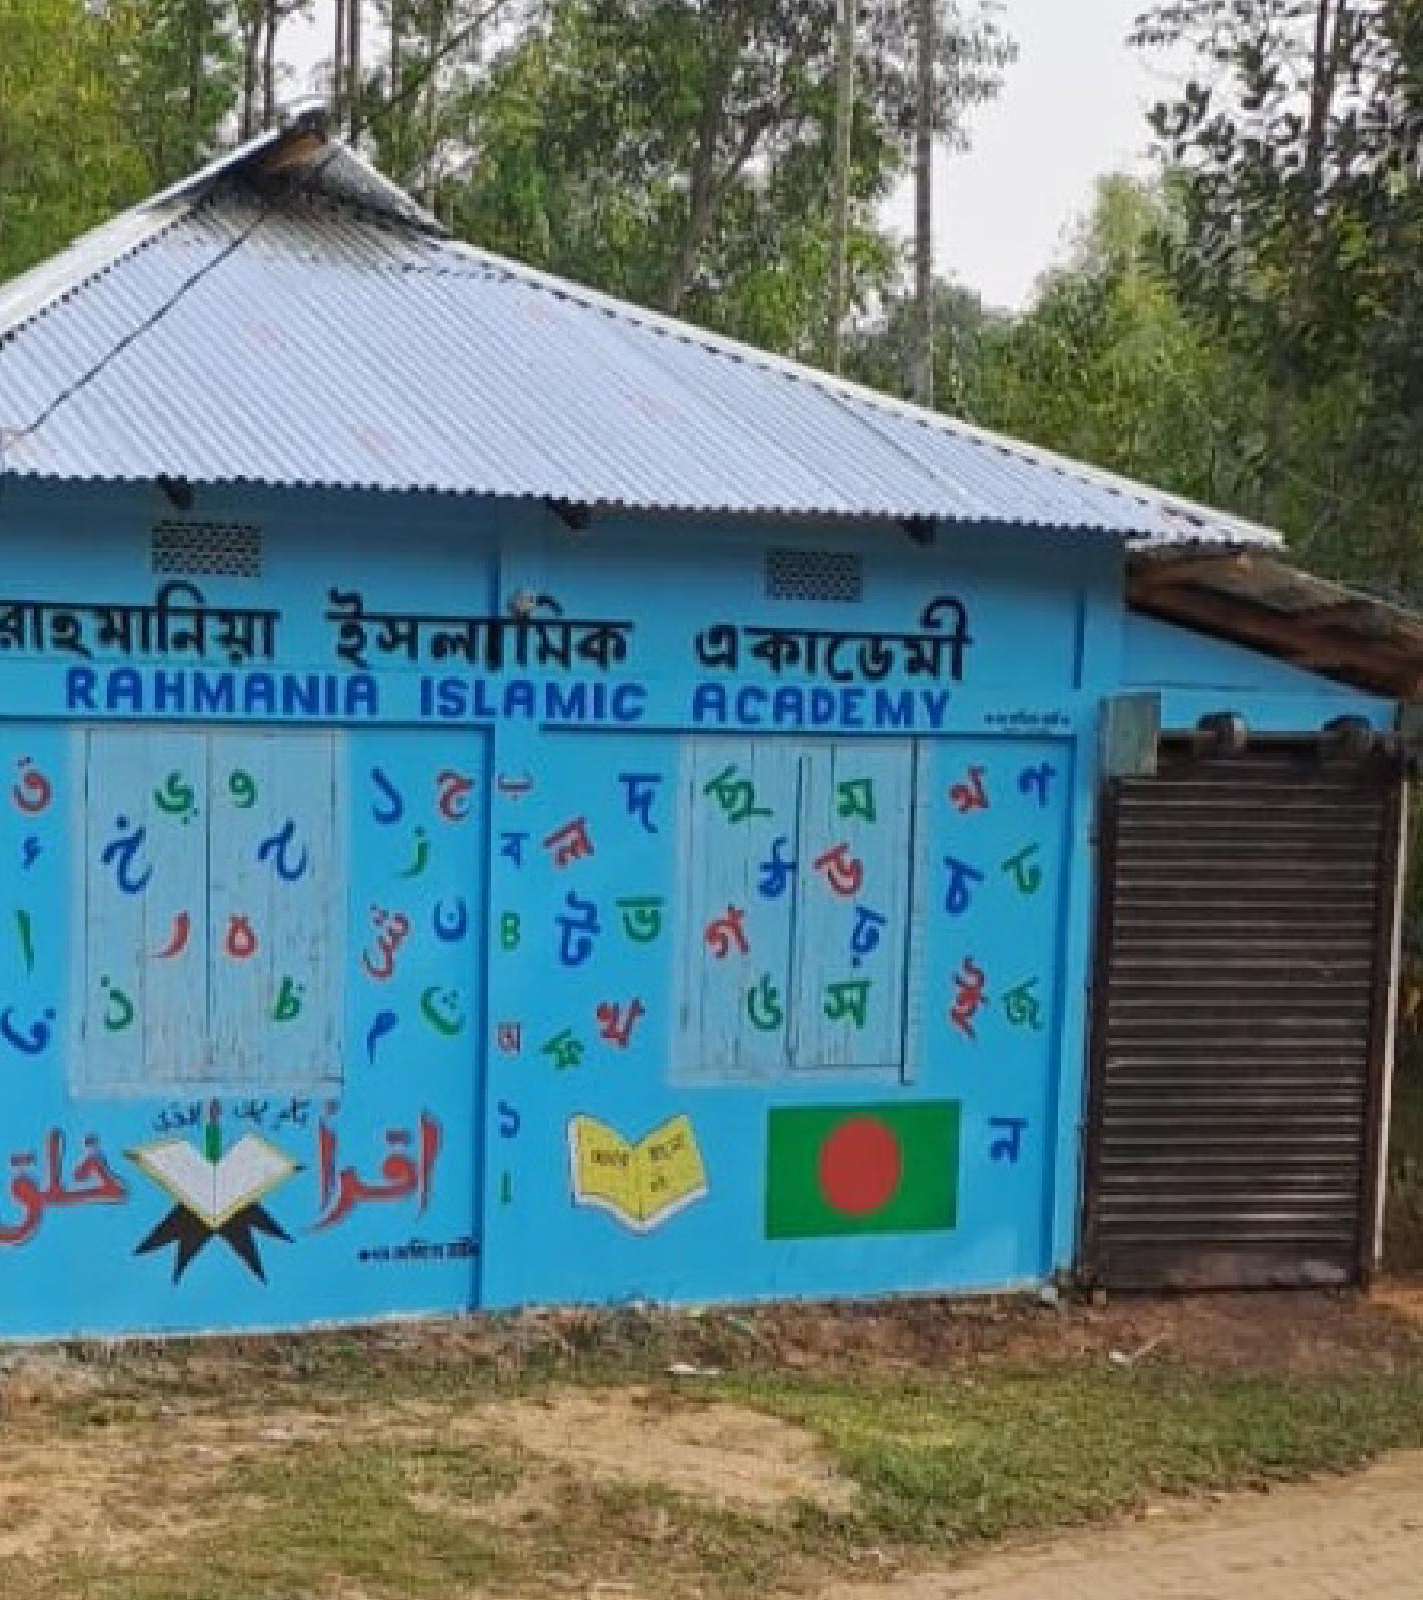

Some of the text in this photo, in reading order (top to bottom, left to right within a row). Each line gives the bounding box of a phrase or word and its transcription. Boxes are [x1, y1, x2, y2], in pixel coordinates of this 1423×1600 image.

[327, 586, 635, 674] ইসলামিক
[694, 596, 973, 682] একাডেমী
[66, 667, 951, 730] RAHMANIA ISLAMIC ACADEMY
